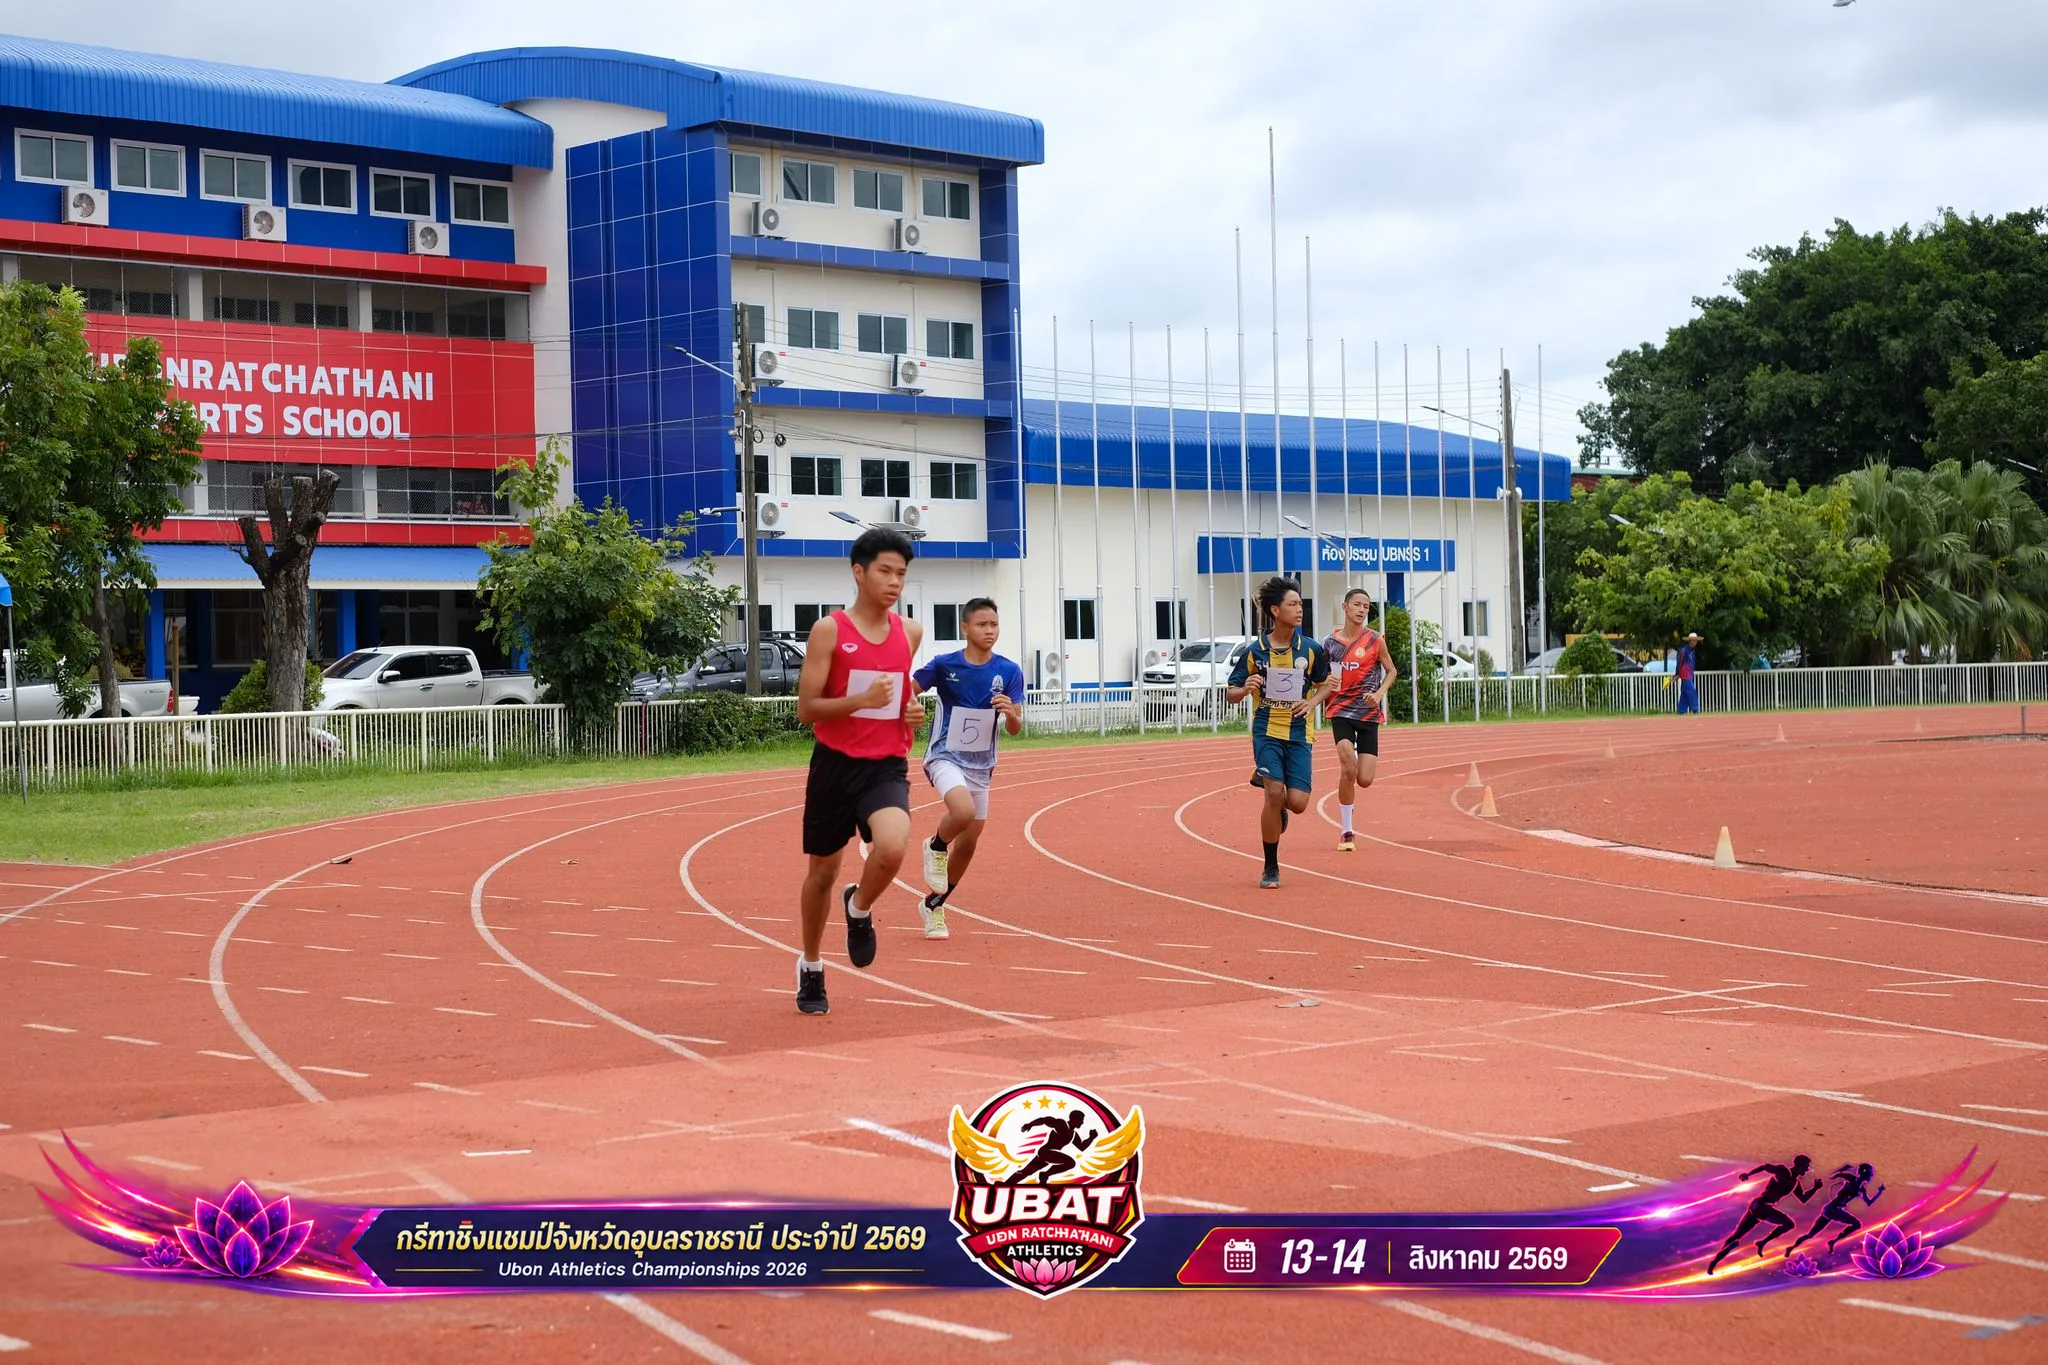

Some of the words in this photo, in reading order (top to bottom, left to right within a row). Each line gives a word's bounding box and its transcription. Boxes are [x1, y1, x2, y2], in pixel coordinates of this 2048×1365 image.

[283, 405, 410, 440] SCHOOL
[1382, 546, 1420, 562] UBNSS
[1424, 547, 1429, 562] 1
[1275, 672, 1293, 693] 3
[960, 718, 982, 745] 5
